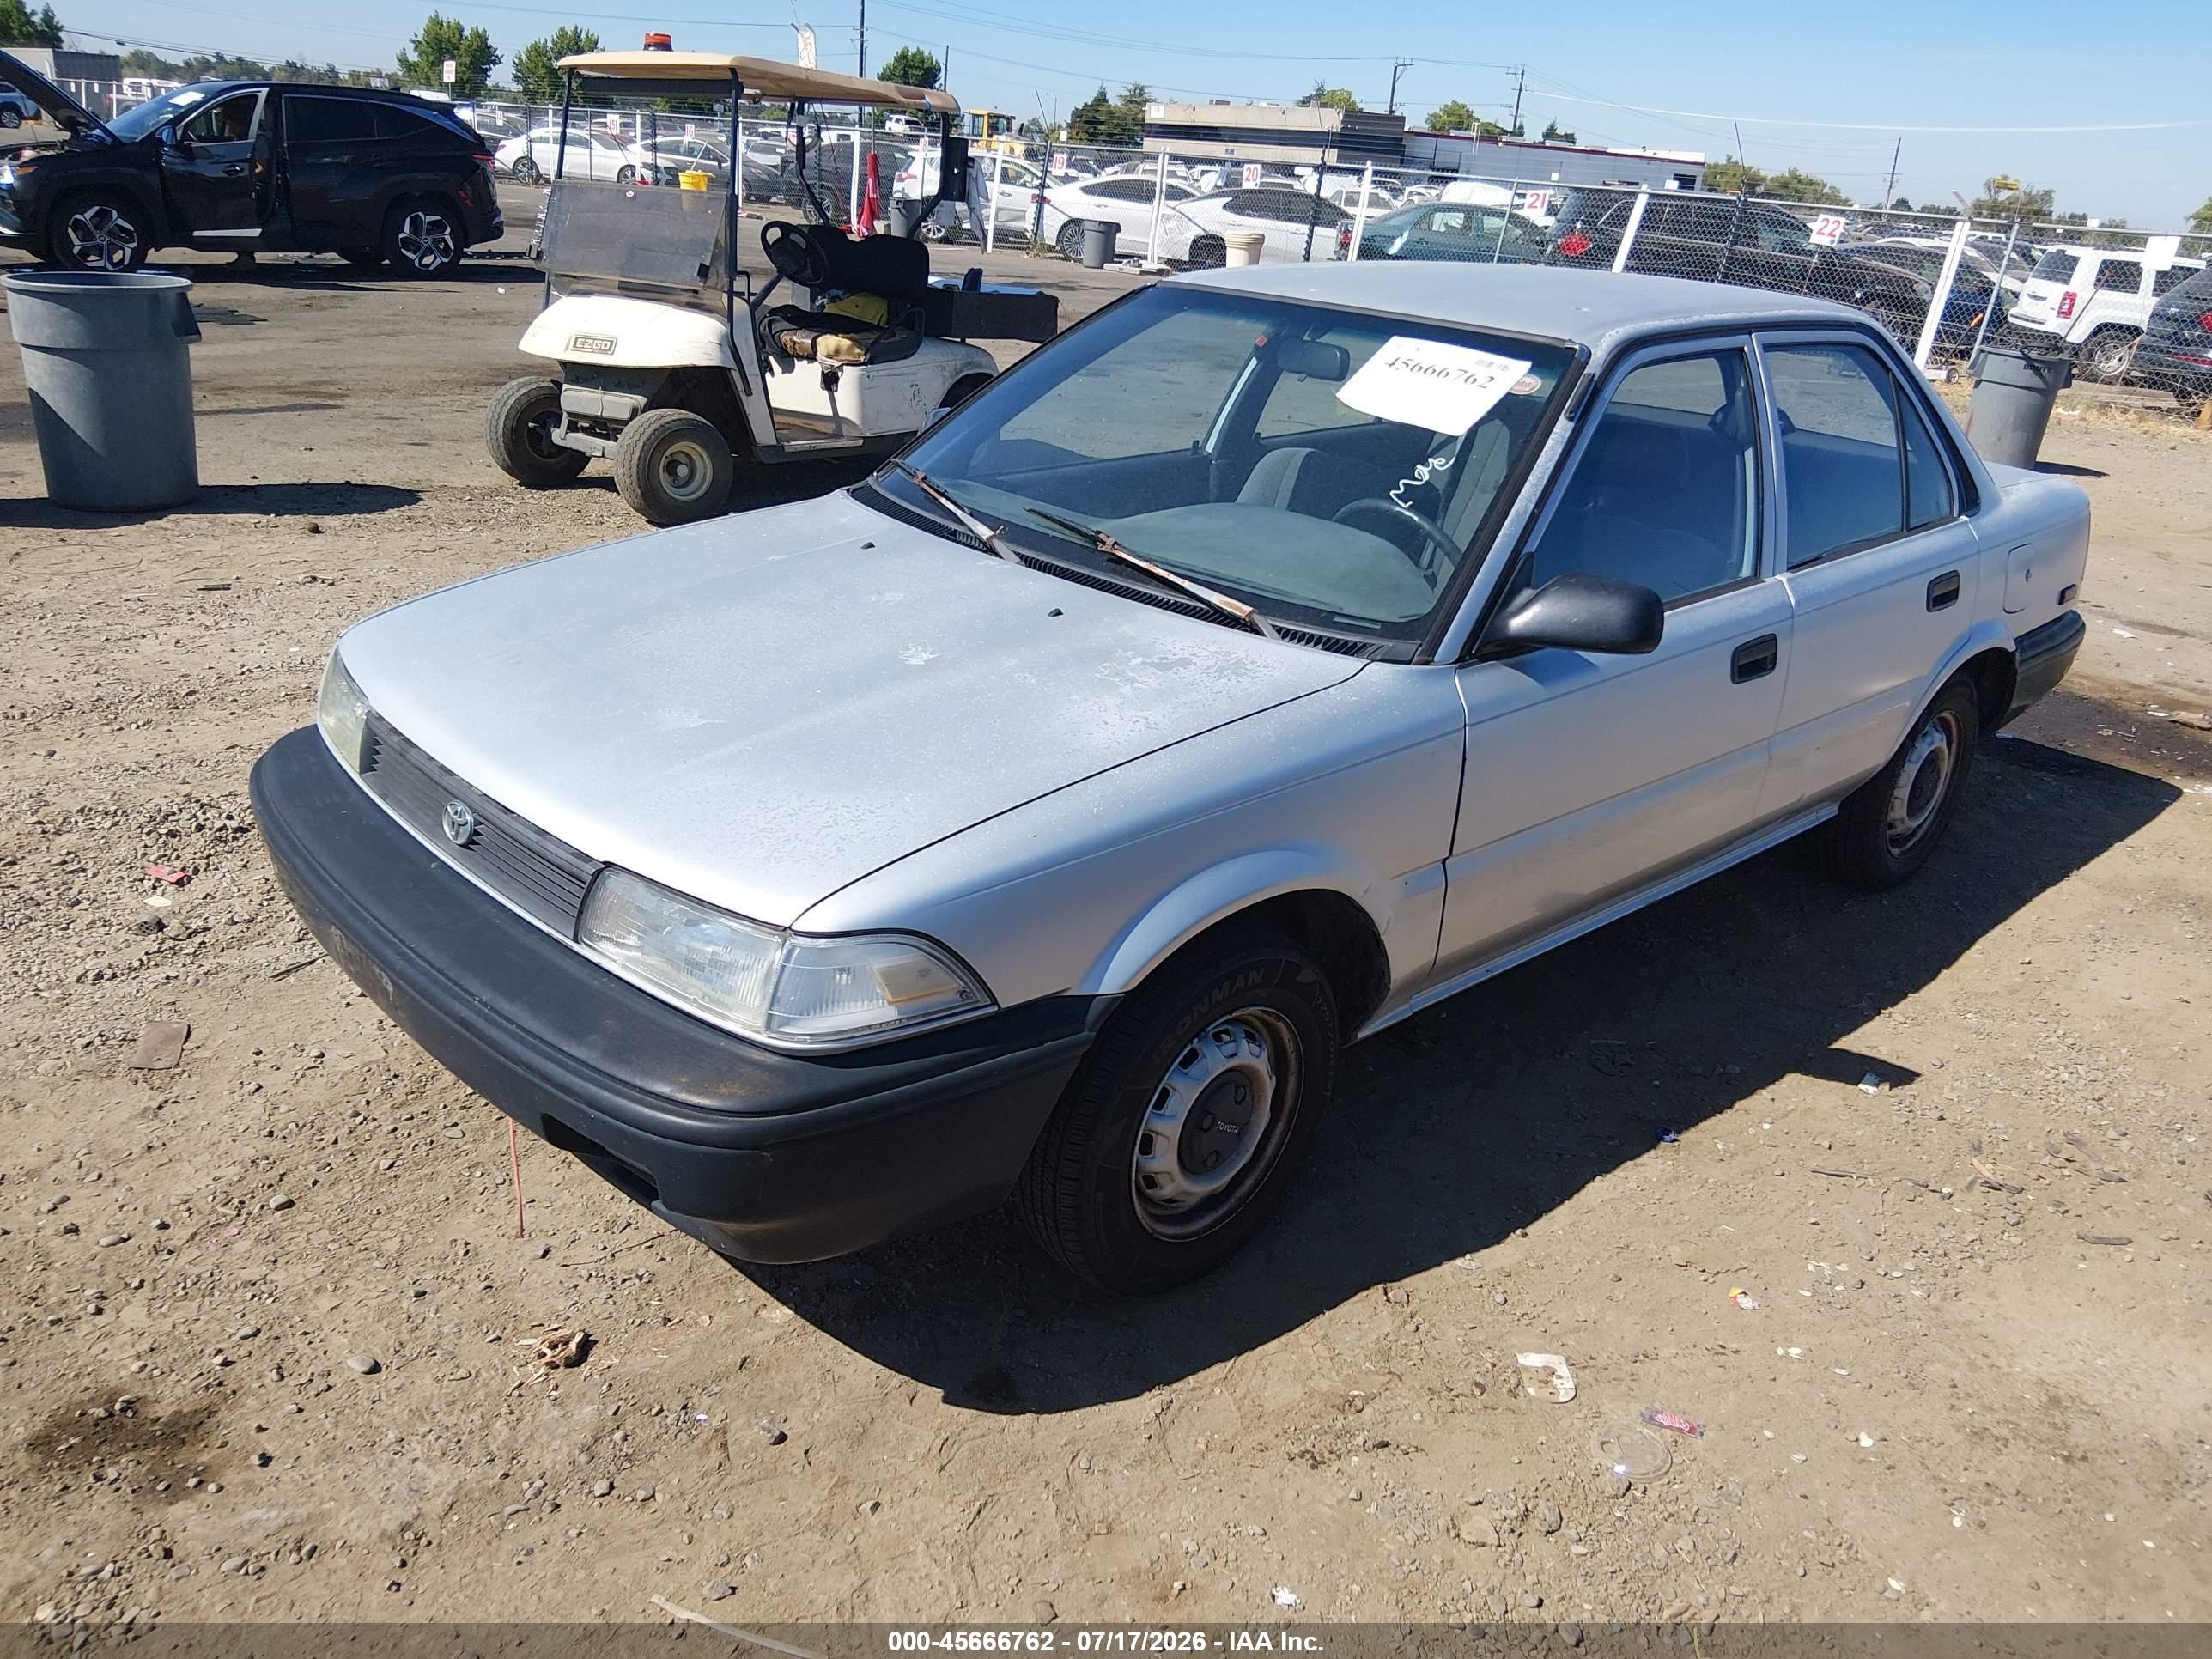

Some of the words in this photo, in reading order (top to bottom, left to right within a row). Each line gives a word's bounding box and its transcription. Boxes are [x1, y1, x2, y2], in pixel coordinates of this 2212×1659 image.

[1054, 156, 1066, 170] 19
[1245, 167, 1259, 182] 20
[1527, 191, 1547, 209] 21
[1815, 217, 1841, 238] 22
[1384, 356, 1495, 389] 45666762
[1215, 1121, 1239, 1133] TOYOTA
